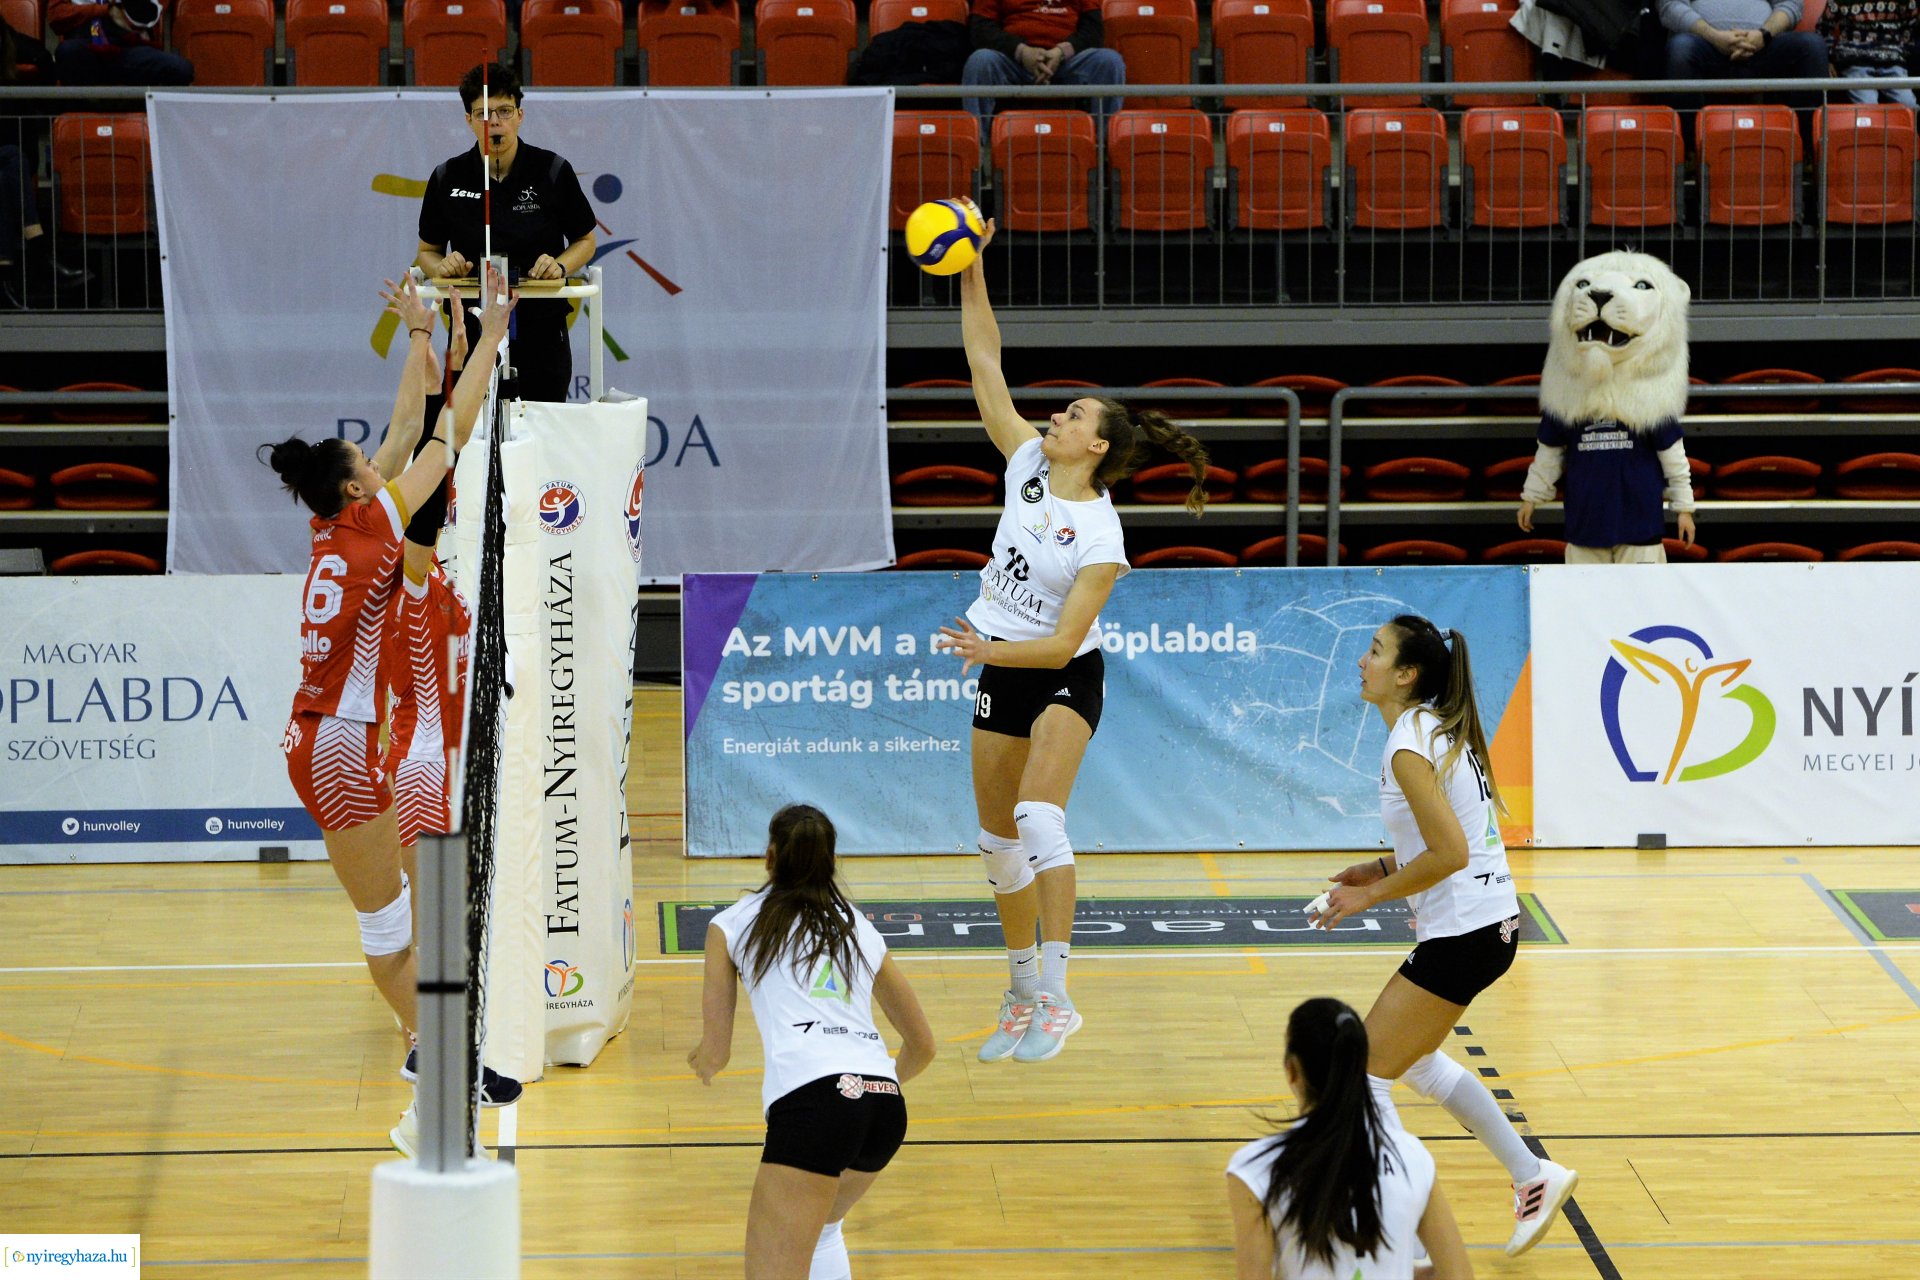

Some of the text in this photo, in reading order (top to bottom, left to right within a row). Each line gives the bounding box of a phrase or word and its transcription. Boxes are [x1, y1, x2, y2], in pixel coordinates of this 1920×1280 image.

[450, 188, 482, 200] Zeus
[545, 481, 574, 491] FATUM
[539, 514, 585, 535] YÍREGYHÁZA
[722, 627, 771, 657] Az
[784, 626, 881, 656] MVM
[895, 632, 916, 655] a
[1102, 622, 1258, 660] öplabda
[23, 643, 137, 664] MAGYAR
[722, 668, 979, 710] sportág támo
[0, 676, 249, 724] PLABDA
[975, 690, 992, 718] 19
[7, 734, 156, 760] SZÖVETSÉG
[723, 737, 960, 757] Energiát adunk a sikerhez
[1803, 754, 1894, 771] MEGYEI
[83, 820, 141, 833] hunvolley
[228, 819, 285, 831] hunvolley
[545, 999, 594, 1010] ÍREGYHÁZA
